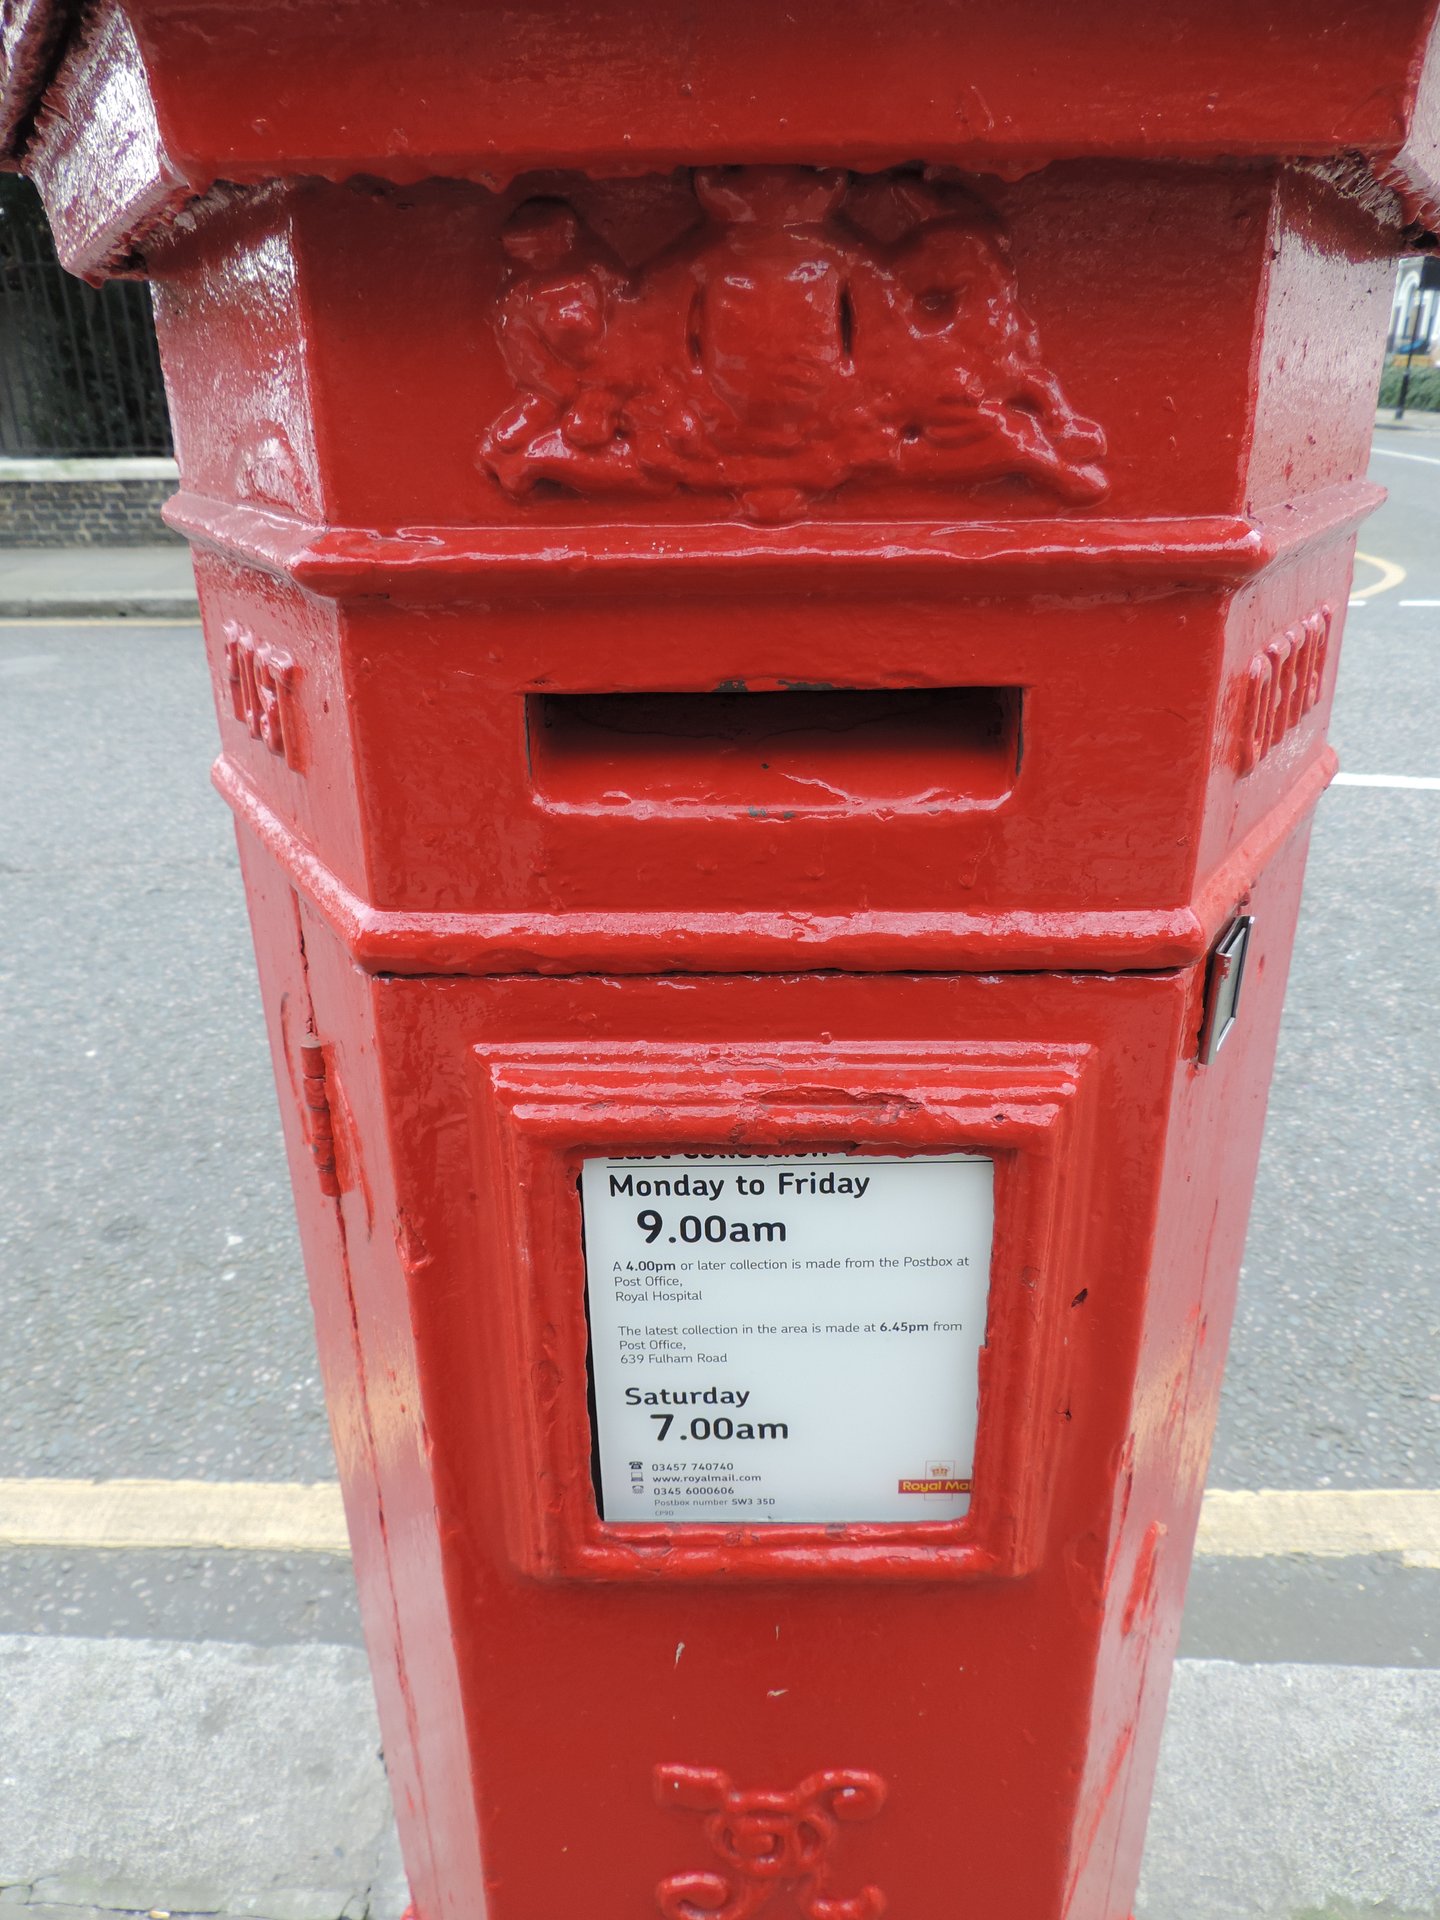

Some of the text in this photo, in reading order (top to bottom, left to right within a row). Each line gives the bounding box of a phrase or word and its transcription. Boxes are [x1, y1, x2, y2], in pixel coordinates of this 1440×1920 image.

[609, 1172, 871, 1200] Monday to Friday
[636, 1209, 787, 1244] 9.00am
[612, 1256, 970, 1273] A 4.00pm or later collection is made from the Postbox at
[614, 1276, 683, 1288] Post Office,
[615, 1290, 703, 1303] Royal Hospital
[618, 1321, 963, 1336] The latest collection in the area is made at 6.45pm from
[619, 1339, 687, 1350] Post Office,
[620, 1352, 728, 1364] 639 Fulham Road
[625, 1387, 751, 1407] Saturday
[650, 1413, 789, 1441] 7.00am
[651, 1462, 734, 1472] 03457 740740
[652, 1473, 762, 1484] www.royalmail.com
[653, 1486, 735, 1496] 0345 6000606
[902, 1480, 973, 1492] Royal Mai
[654, 1499, 690, 1507] Postbox
[692, 1498, 728, 1506] number
[731, 1498, 753, 1506] SW3
